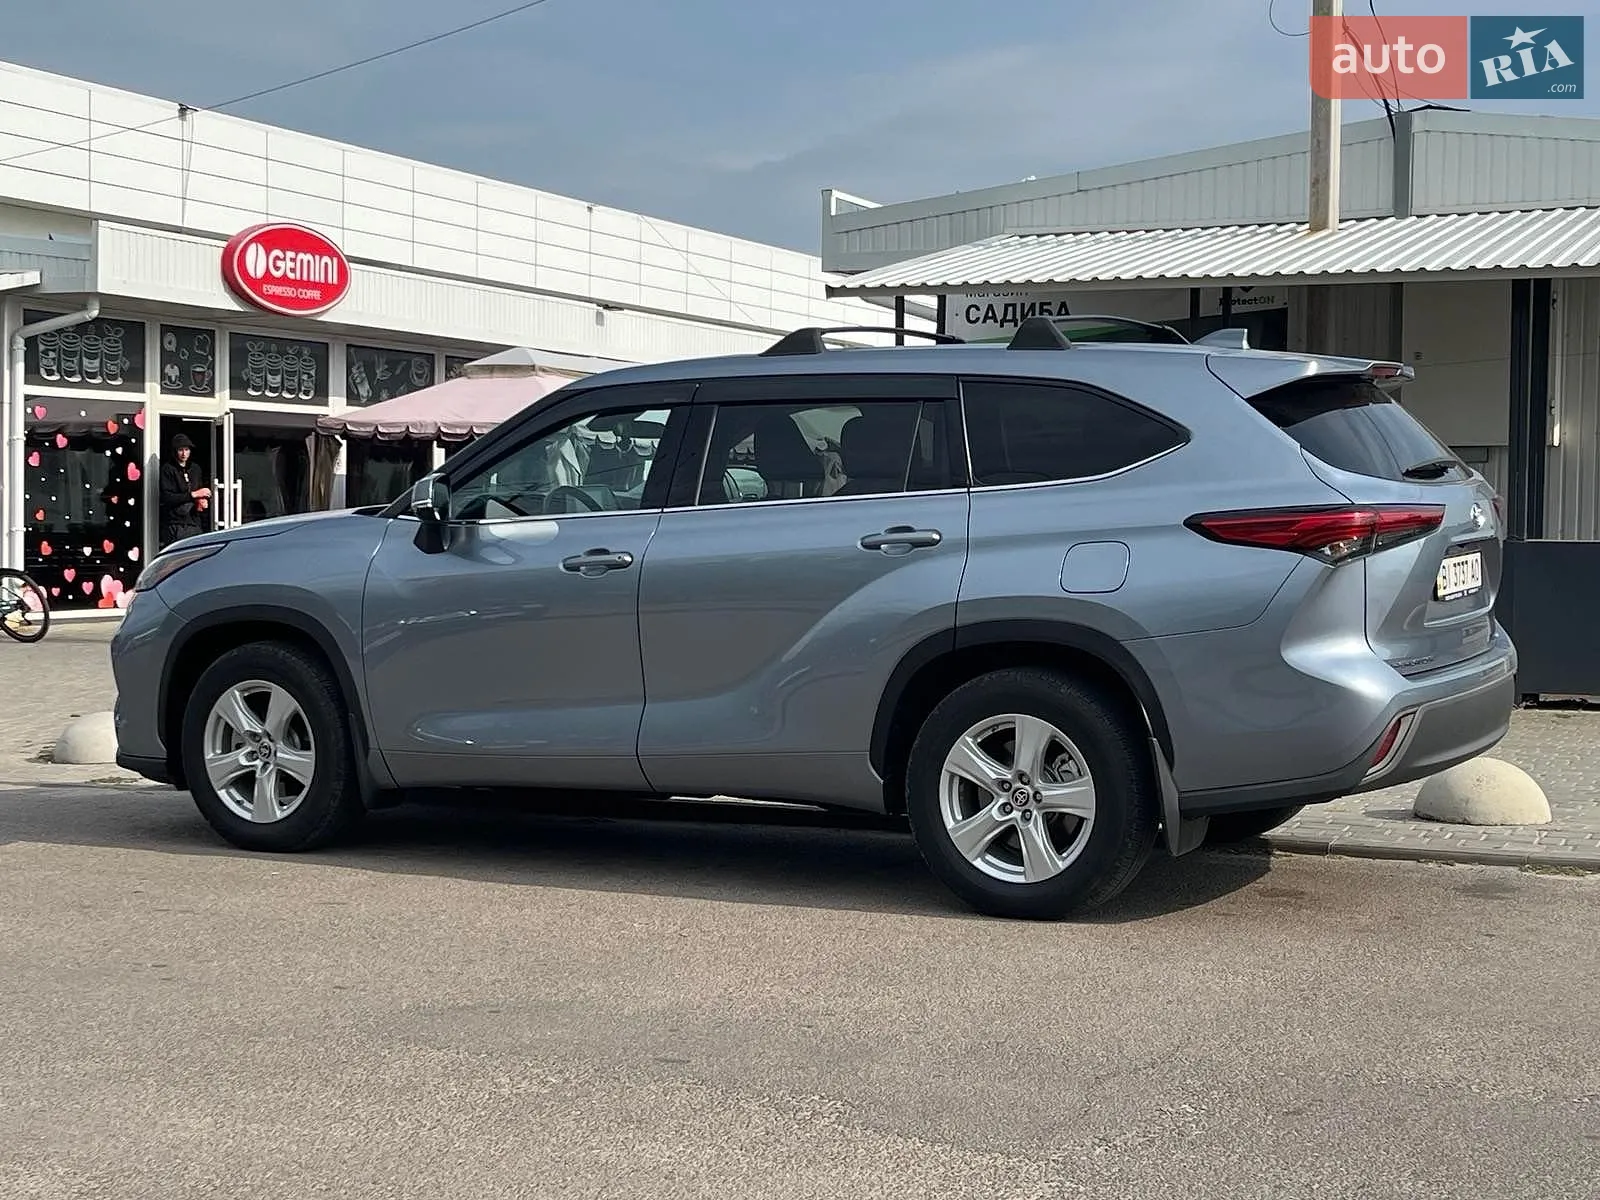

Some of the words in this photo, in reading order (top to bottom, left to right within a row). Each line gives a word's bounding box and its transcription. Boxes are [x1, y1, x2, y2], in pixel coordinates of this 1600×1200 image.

[268, 249, 338, 285] GEMINI
[262, 283, 297, 298] ESPRESSO
[297, 288, 322, 301] COFFEE
[1219, 296, 1275, 306] otectON
[965, 301, 1071, 328] САДИБА
